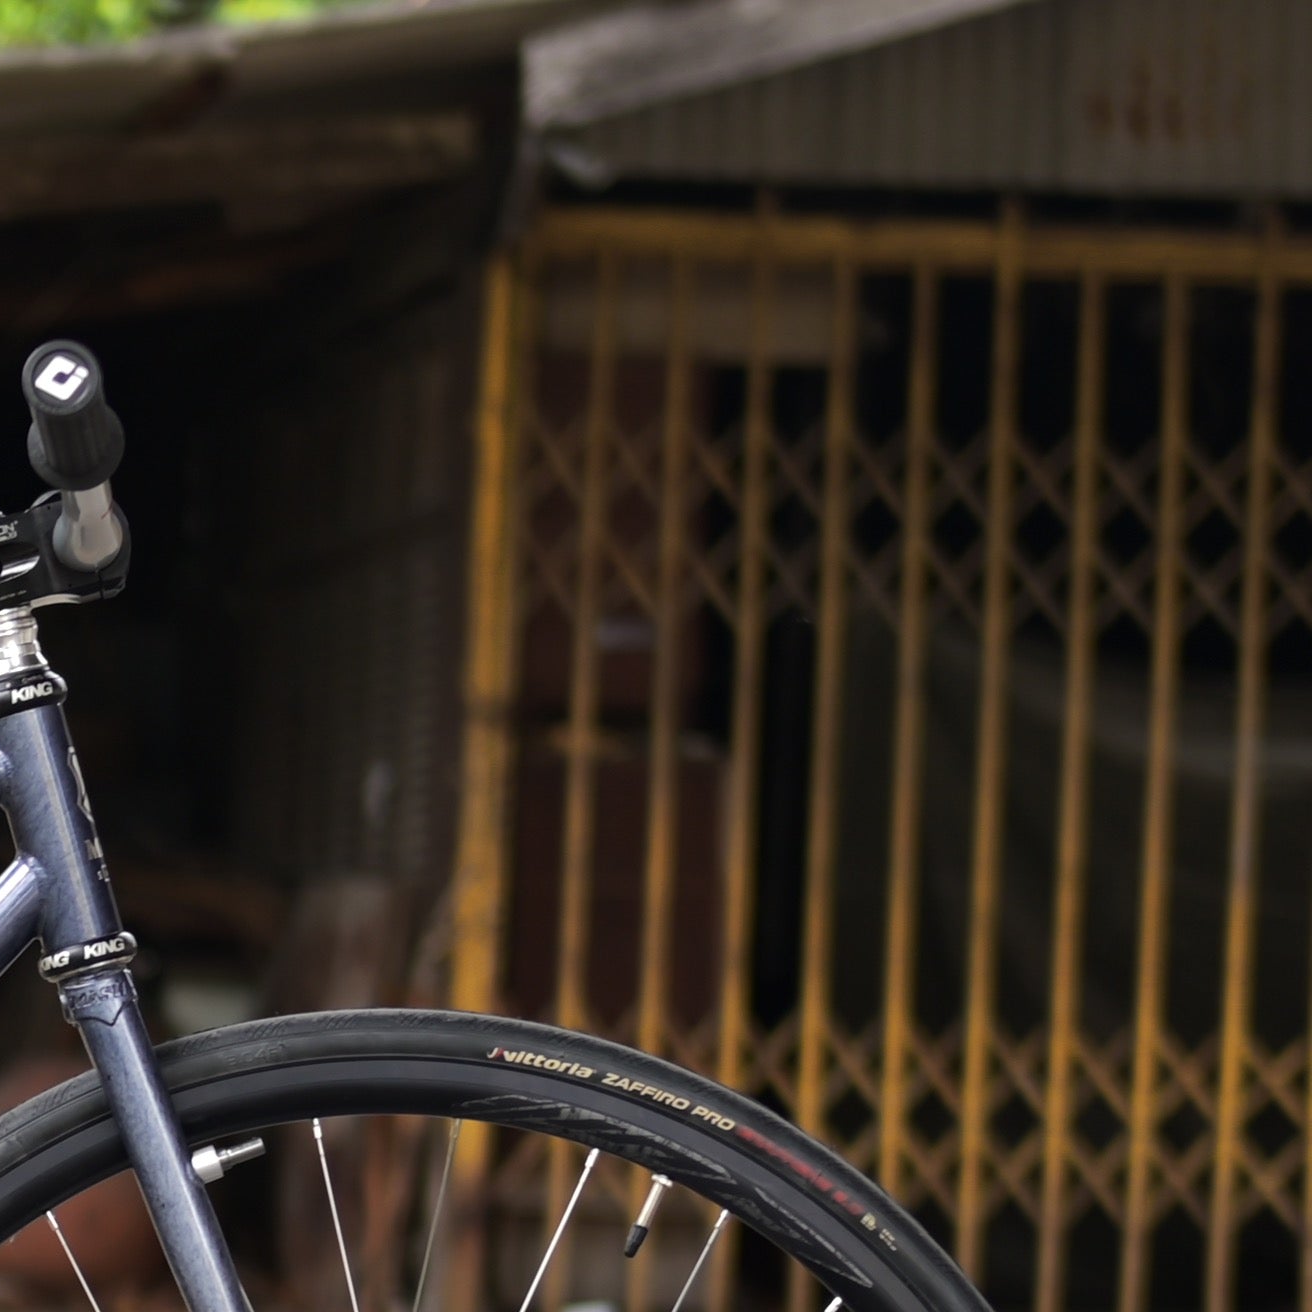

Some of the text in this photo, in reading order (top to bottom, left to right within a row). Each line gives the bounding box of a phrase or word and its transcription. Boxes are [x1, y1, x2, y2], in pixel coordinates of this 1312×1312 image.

[11, 681, 53, 704] KING
[84, 938, 125, 960] KING
[501, 1048, 736, 1131] vittoria ZAFFIRO PRO
